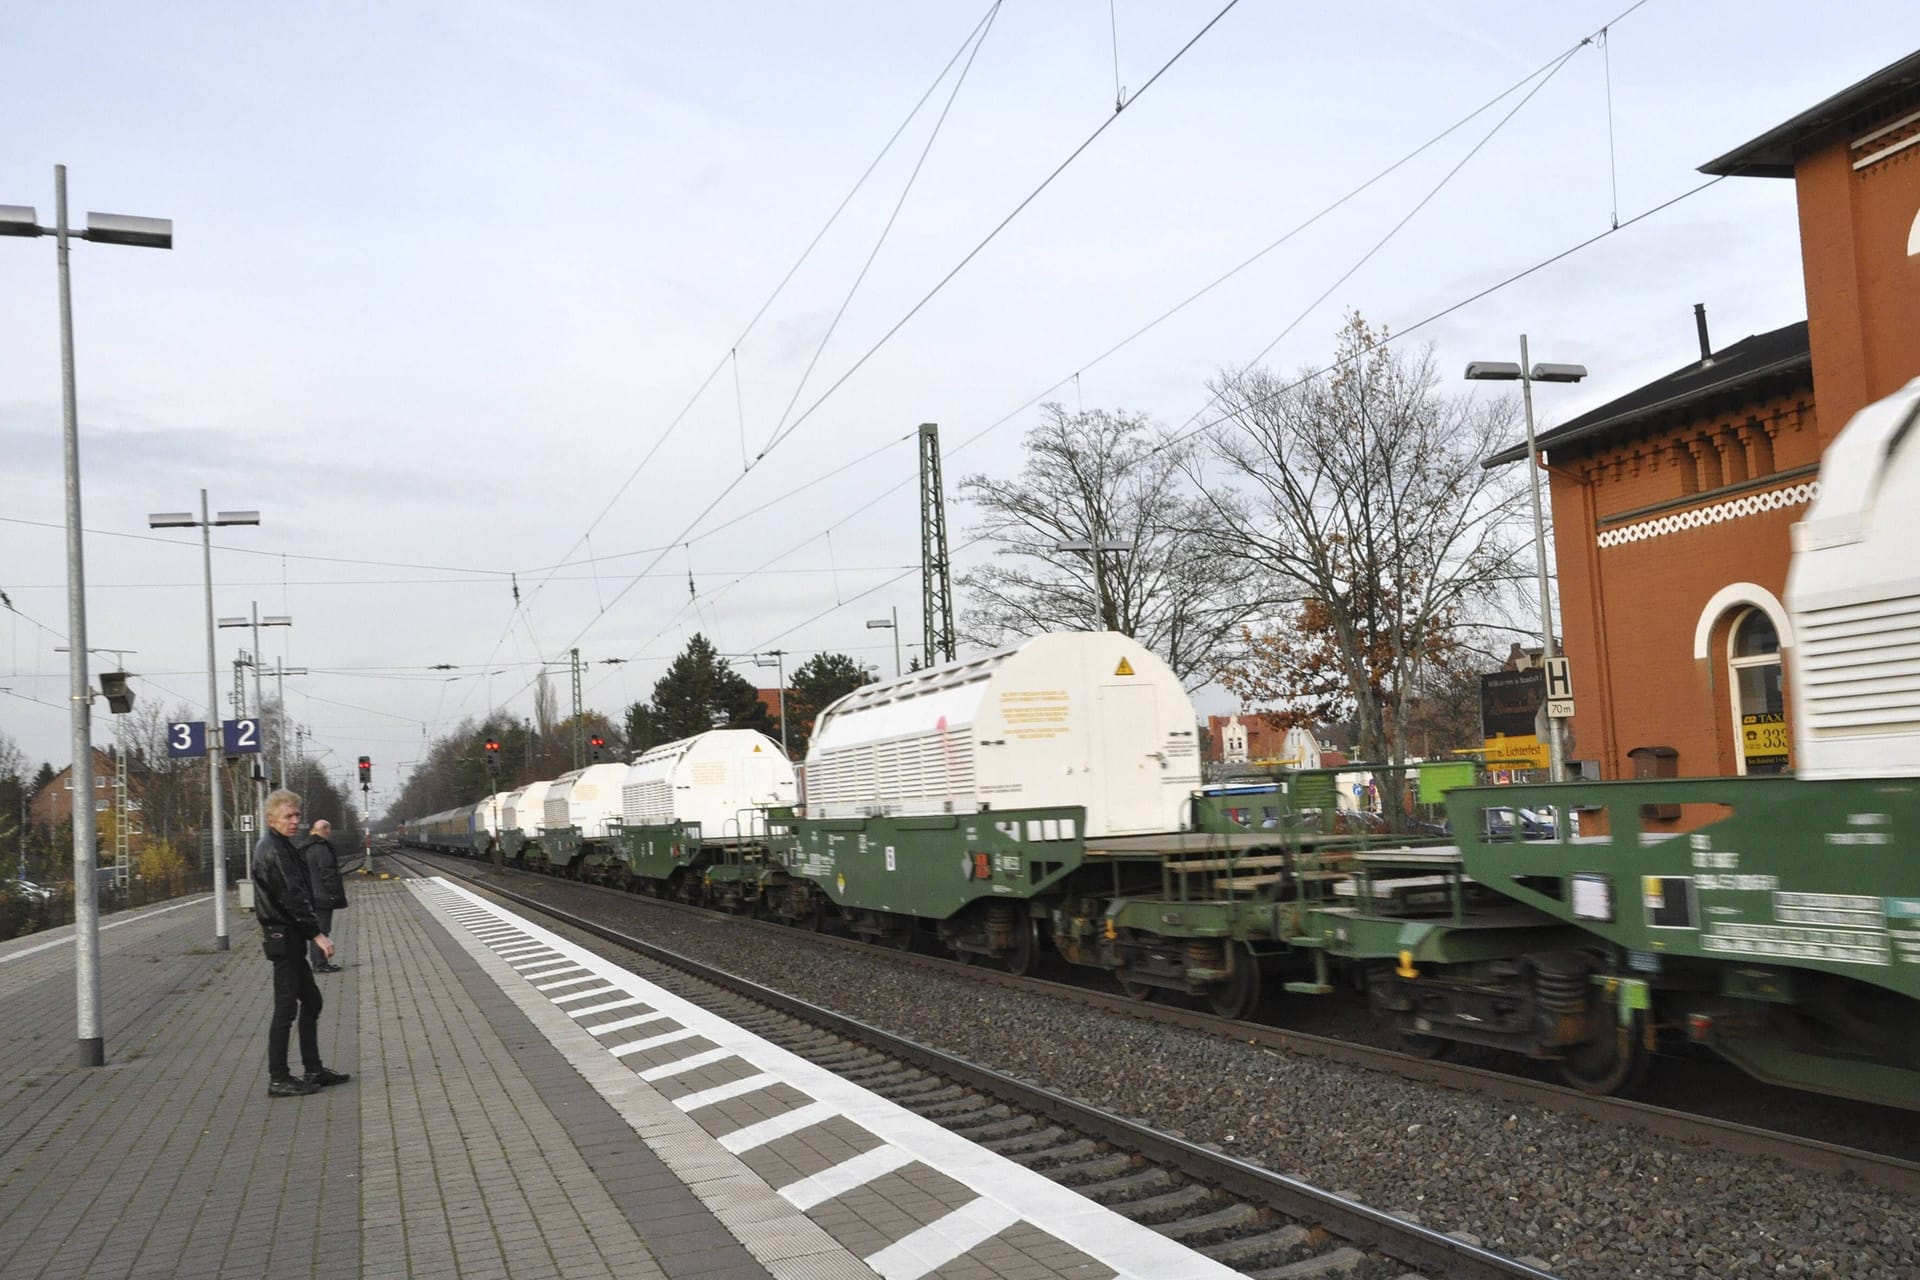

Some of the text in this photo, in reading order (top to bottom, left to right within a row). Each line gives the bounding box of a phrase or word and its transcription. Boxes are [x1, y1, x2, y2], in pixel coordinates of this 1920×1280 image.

[1547, 660, 1569, 695] H
[172, 723, 192, 750] 3
[237, 720, 257, 746] 2
[1506, 744, 1541, 757] Lichterfest
[242, 816, 252, 830] H
